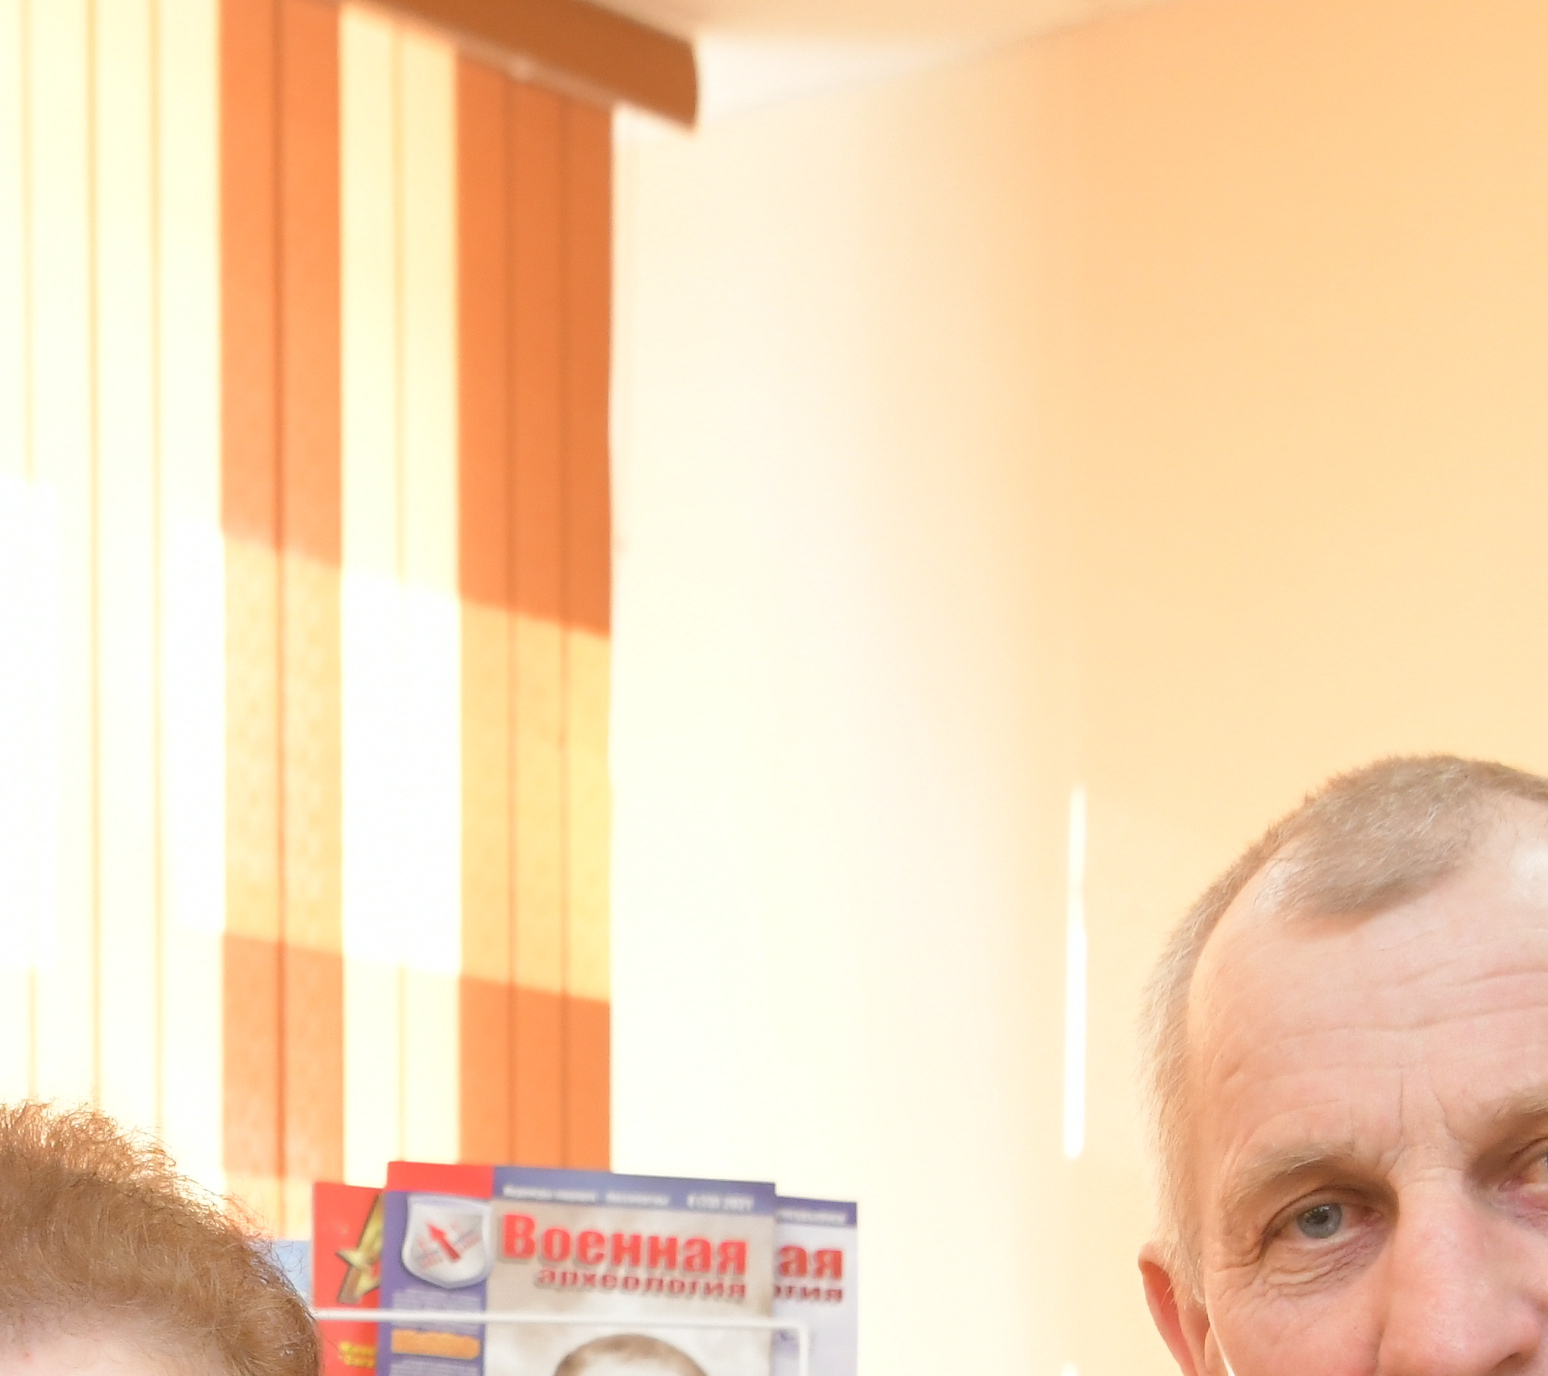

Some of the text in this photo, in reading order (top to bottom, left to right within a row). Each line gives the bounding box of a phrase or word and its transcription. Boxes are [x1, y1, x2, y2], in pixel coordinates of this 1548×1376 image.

[502, 1213, 747, 1276] Военная
[779, 1244, 843, 1279] ая
[537, 1267, 746, 1299] археология
